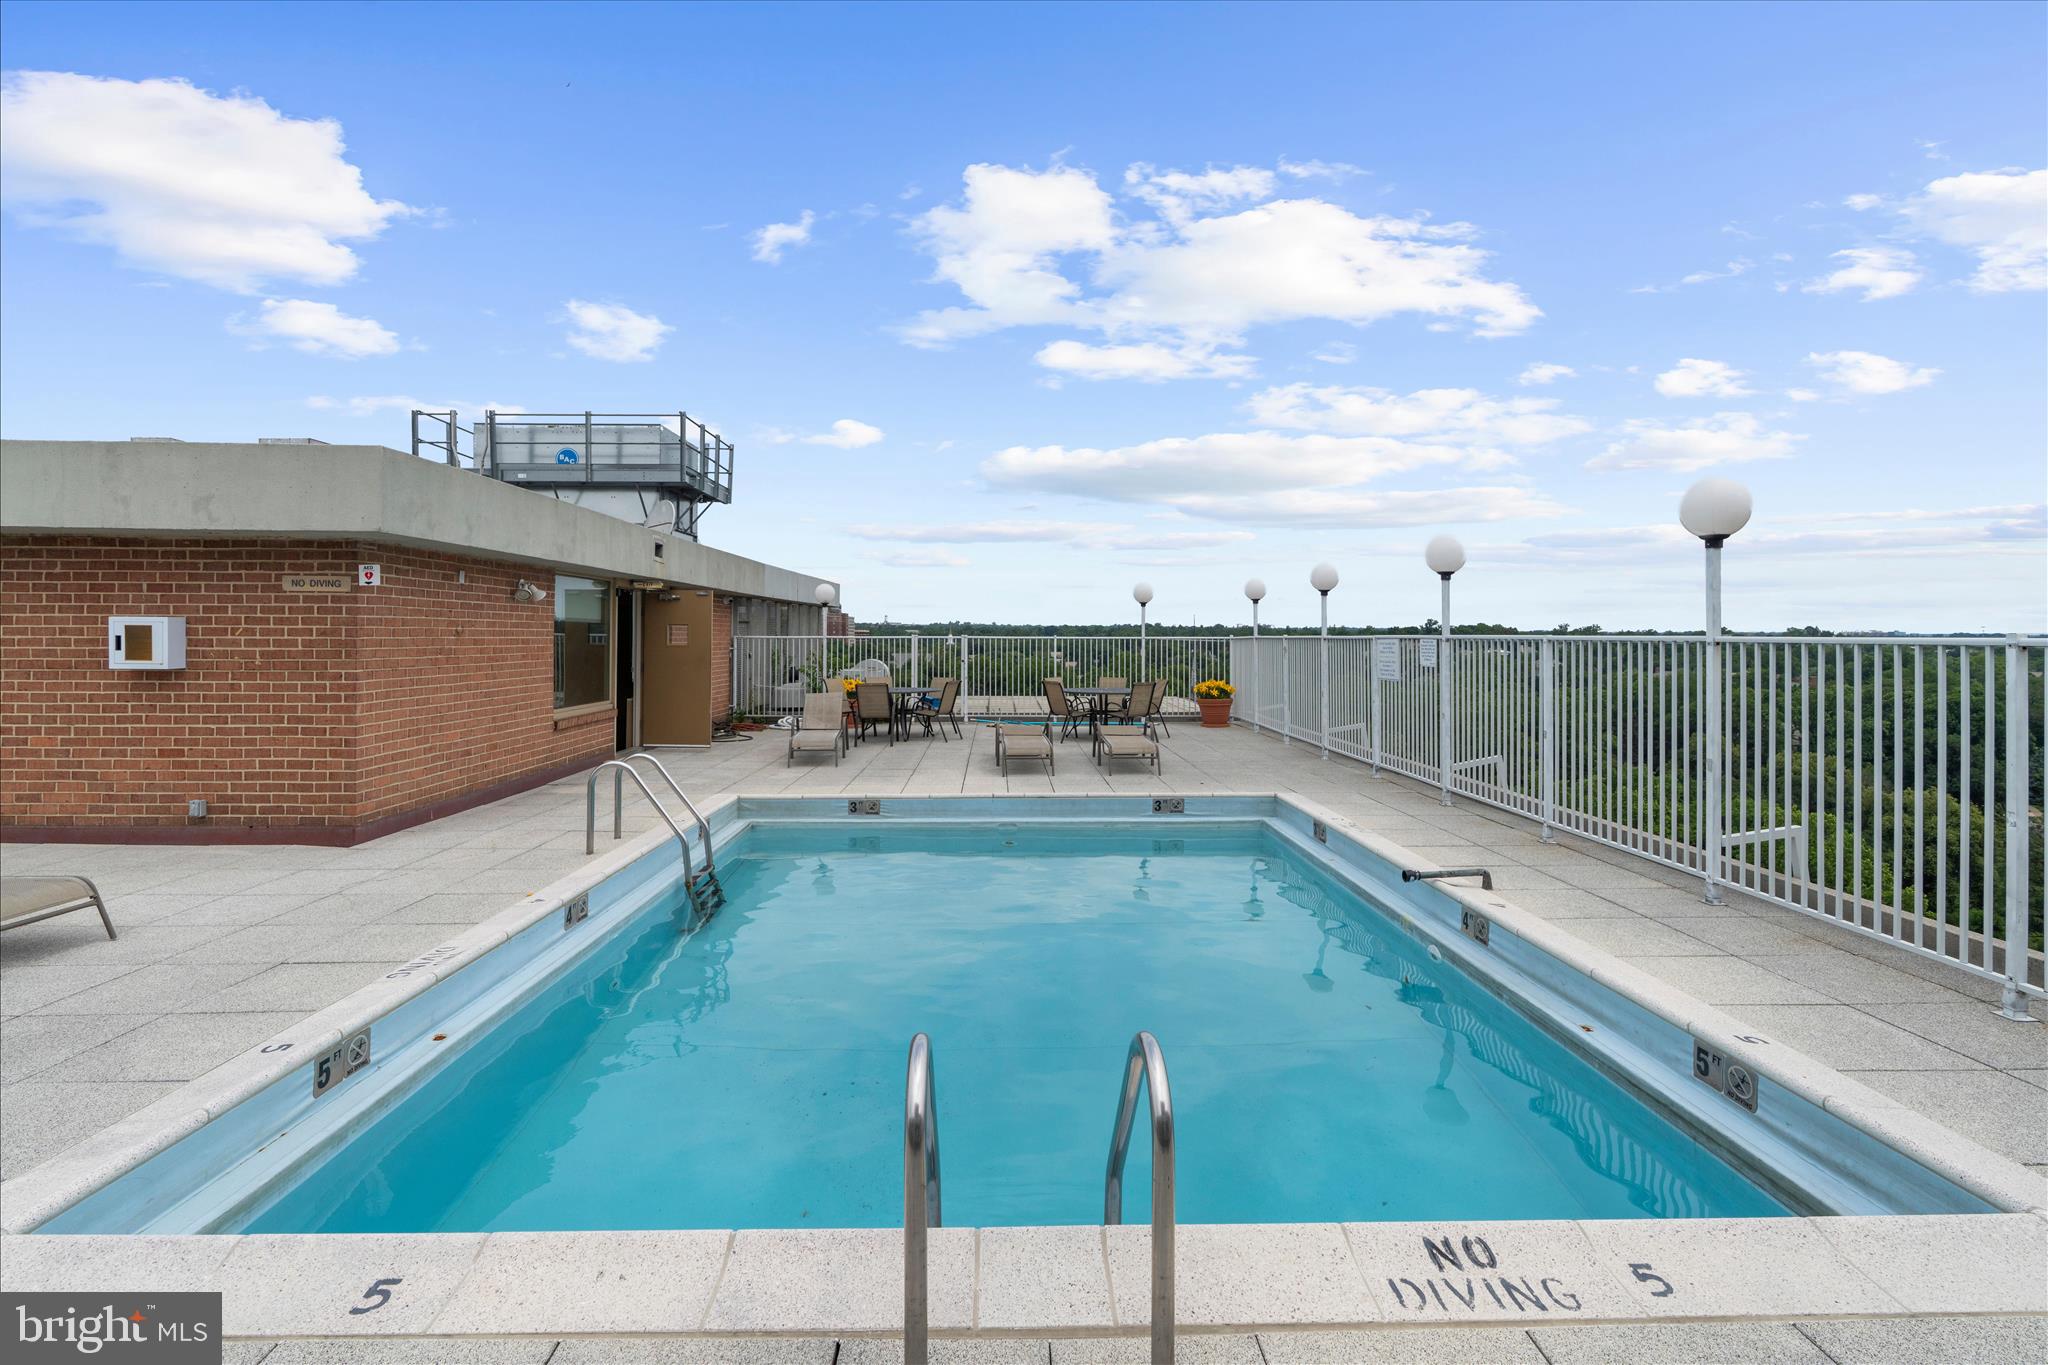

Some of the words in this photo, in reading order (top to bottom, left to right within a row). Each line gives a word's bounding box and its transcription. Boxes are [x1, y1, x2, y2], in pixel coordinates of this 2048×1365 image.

[291, 579, 305, 587] NO
[309, 579, 342, 588] DIVING
[850, 801, 857, 813] 3
[1154, 800, 1162, 812] 3
[566, 903, 573, 923] 4
[1462, 911, 1469, 930] 4
[317, 1057, 331, 1089] 5
[333, 1049, 343, 1062] FT
[1696, 1046, 1710, 1077] 5
[1712, 1054, 1721, 1067] FT
[1422, 1235, 1498, 1273] NO
[1387, 1276, 1583, 1313] DIVING
[1628, 1262, 1674, 1298] 5
[348, 1278, 403, 1315] 5
